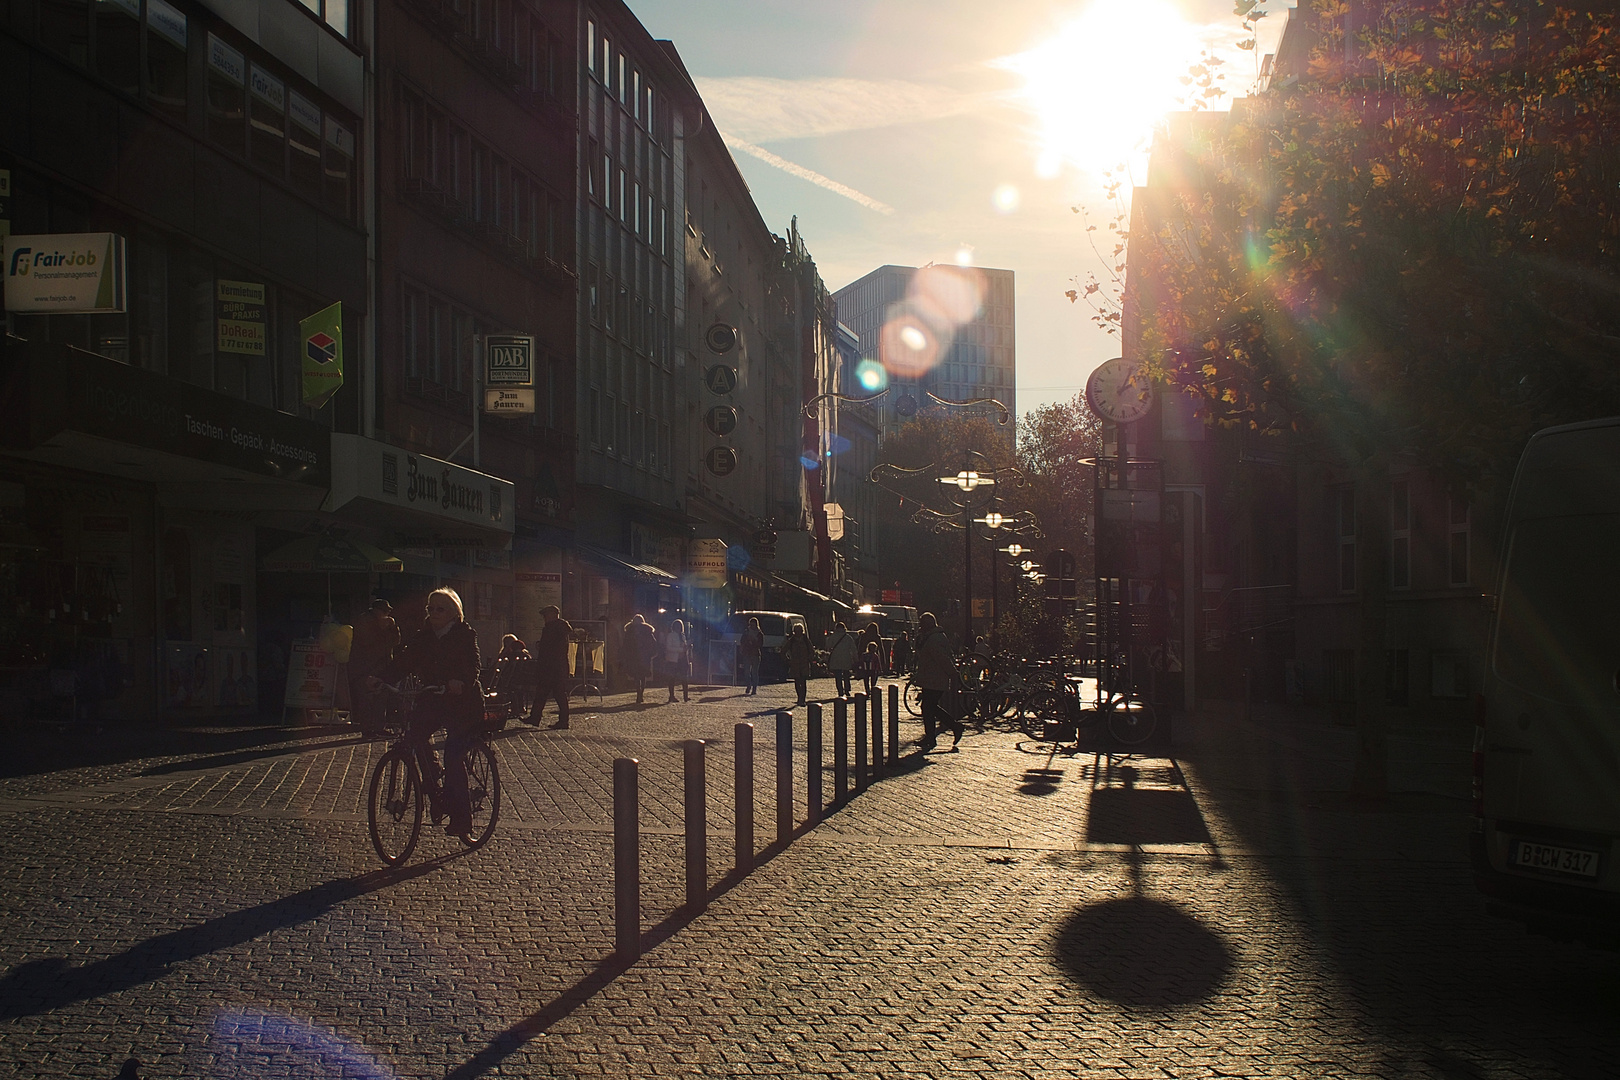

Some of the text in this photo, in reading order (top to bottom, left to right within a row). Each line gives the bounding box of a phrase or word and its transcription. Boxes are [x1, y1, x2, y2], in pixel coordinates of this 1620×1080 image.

[34, 271, 98, 280] Personalmanagement
[34, 295, 76, 303] www.fairjob.de
[221, 284, 263, 301] Vermietung
[223, 302, 245, 312] BÜRO
[232, 310, 261, 320] PRAXIS
[494, 347, 525, 367] DAB
[499, 391, 518, 401] Zum
[494, 400, 525, 410] Sauren
[185, 413, 318, 464] Taschen Gepäck Accessoires
[407, 453, 484, 514] Zum Sauren
[304, 653, 326, 669] 90
[1522, 844, 1592, 873] B CW 317
